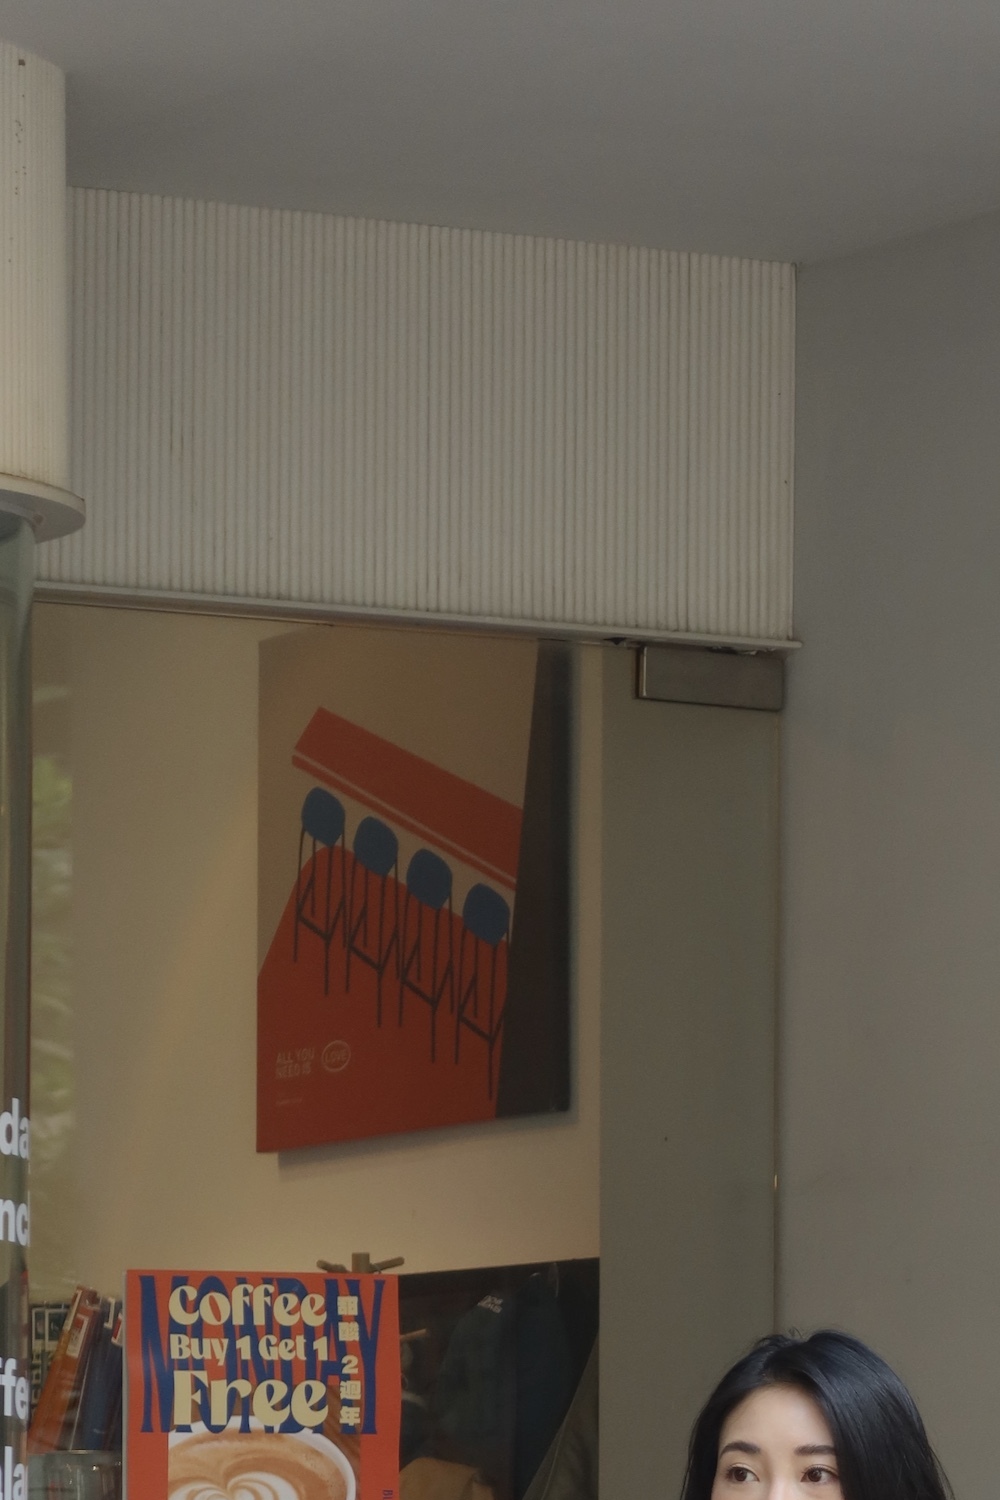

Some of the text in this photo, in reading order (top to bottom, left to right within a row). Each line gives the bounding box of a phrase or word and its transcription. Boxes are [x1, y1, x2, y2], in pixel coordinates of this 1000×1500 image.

[169, 1284, 327, 1326] Coffee
[170, 1334, 328, 1366] Buy 1 Get 1
[173, 1370, 329, 1427] Free
